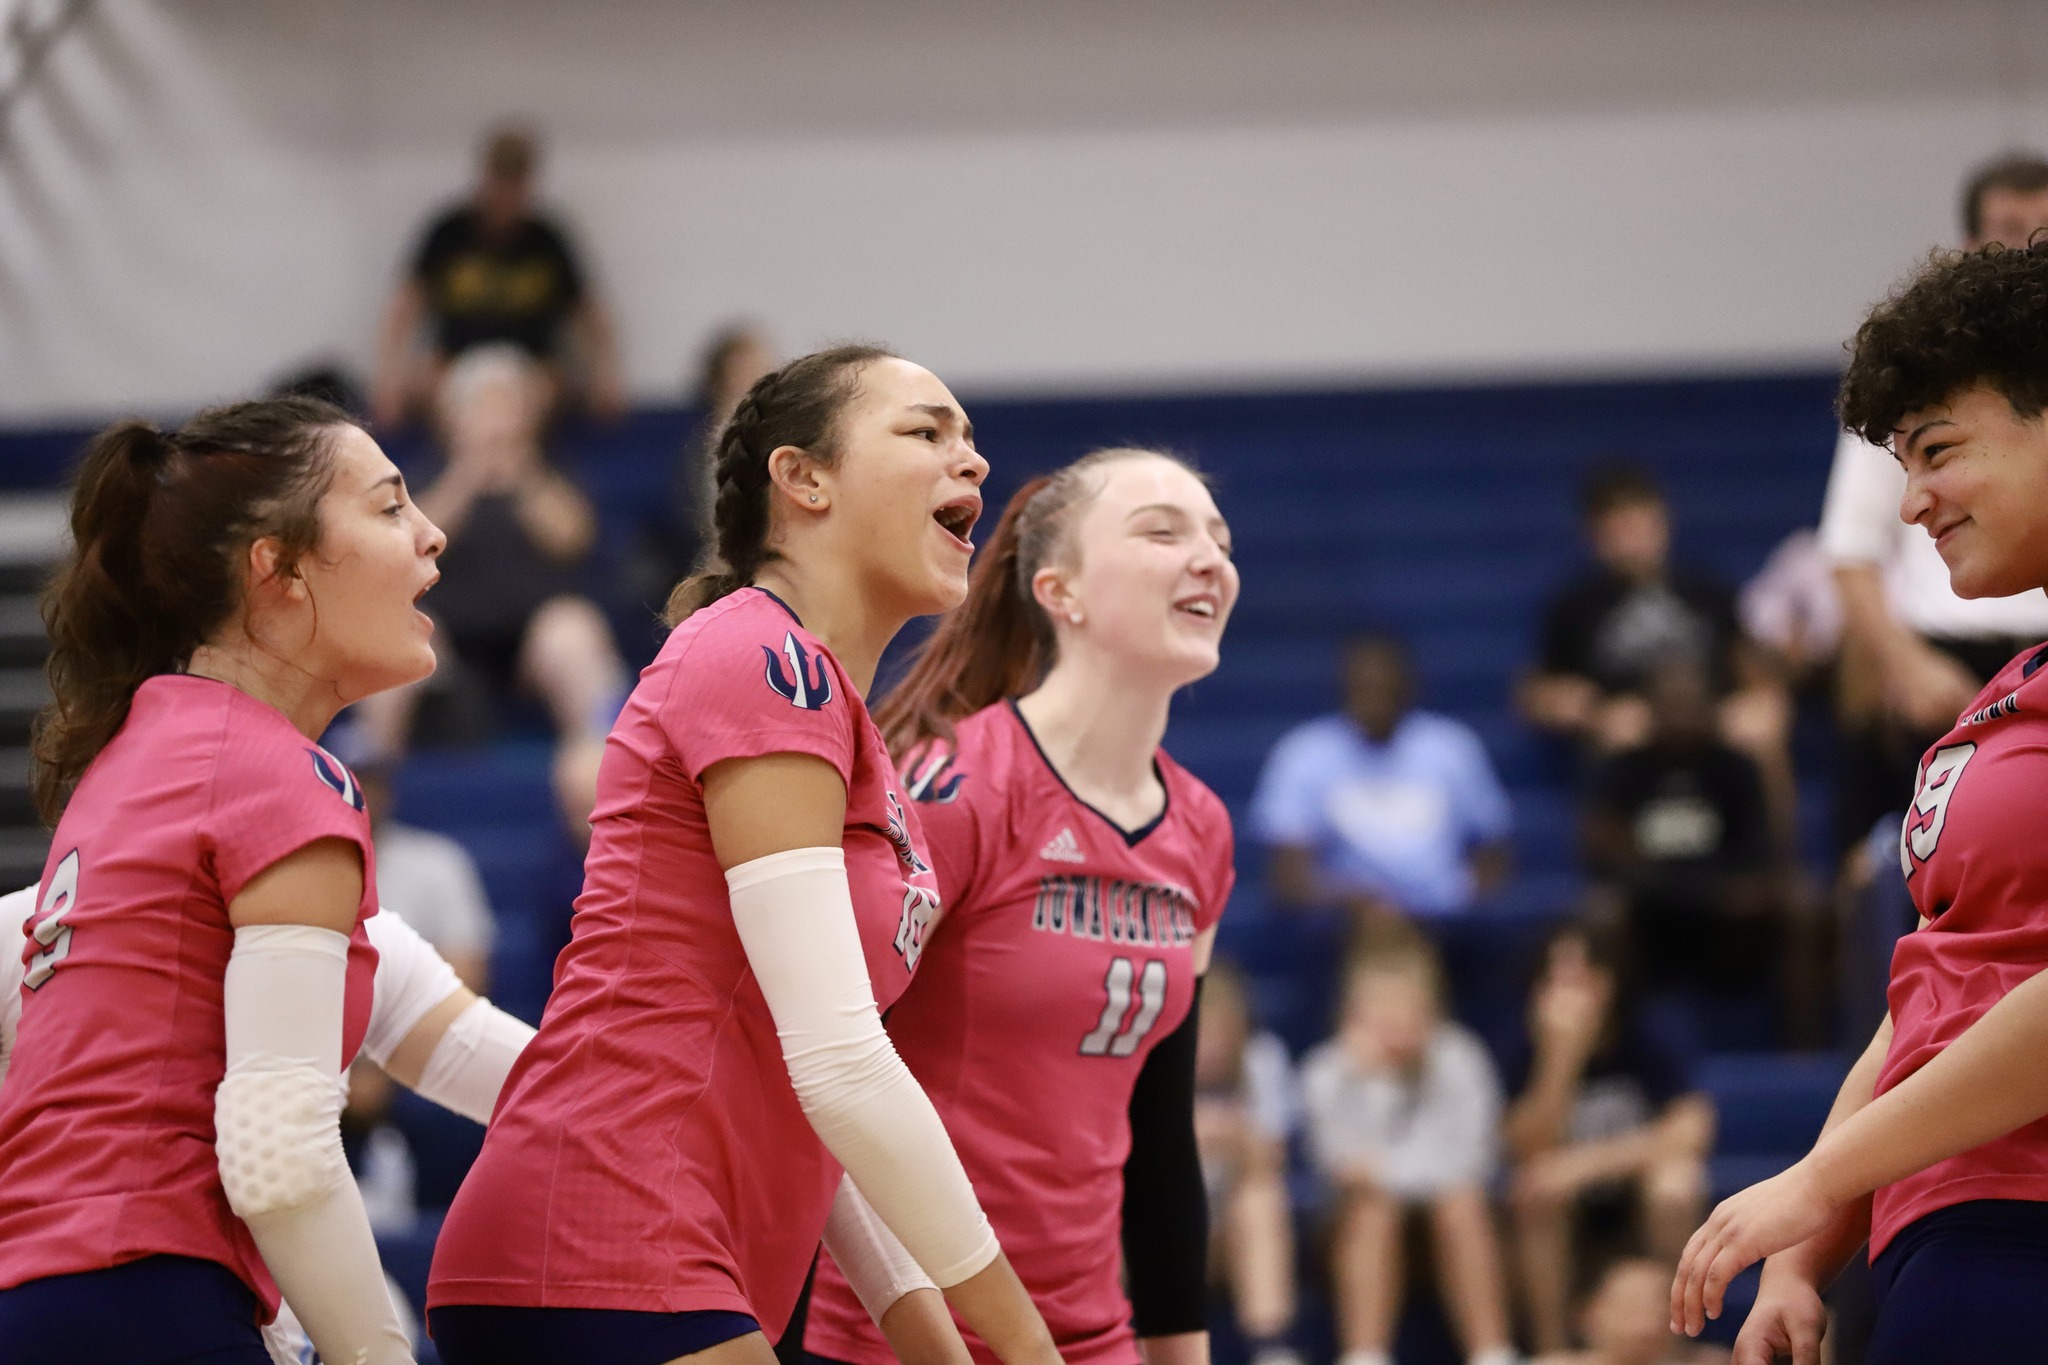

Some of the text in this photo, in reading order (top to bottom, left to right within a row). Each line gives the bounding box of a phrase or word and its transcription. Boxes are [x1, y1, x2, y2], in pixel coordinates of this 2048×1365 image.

[1900, 741, 1978, 881] 19
[1032, 875, 1105, 941] IOWA
[1078, 956, 1168, 1058] 11
